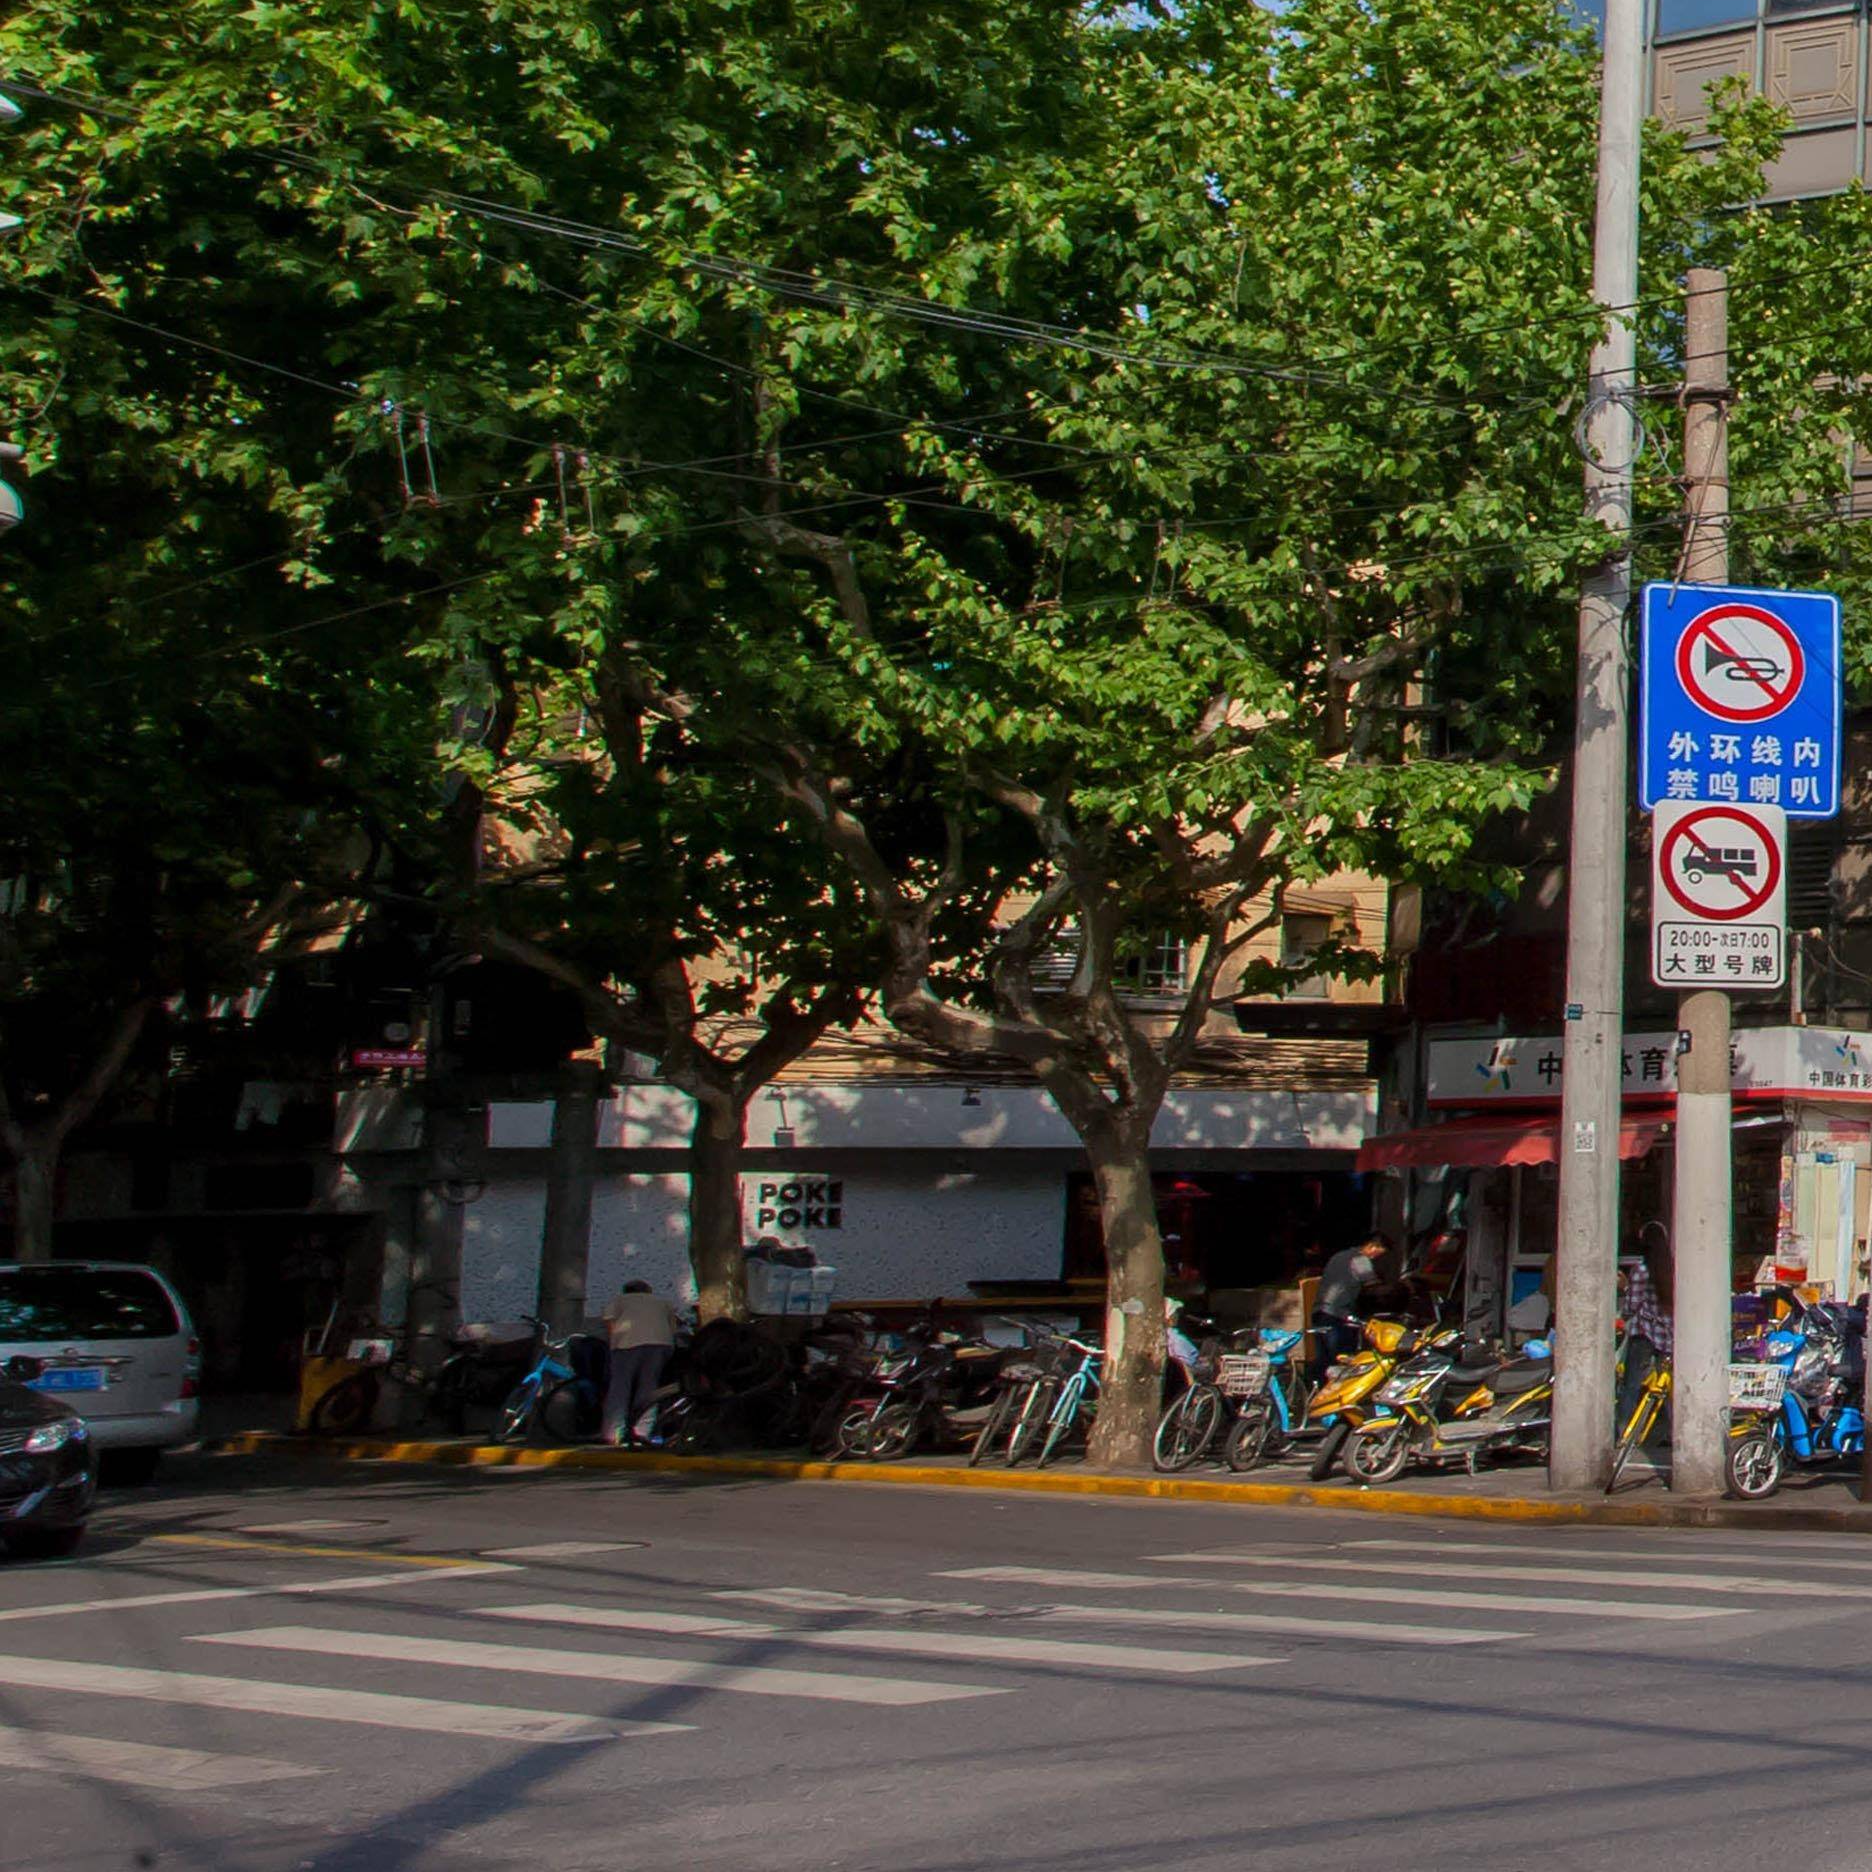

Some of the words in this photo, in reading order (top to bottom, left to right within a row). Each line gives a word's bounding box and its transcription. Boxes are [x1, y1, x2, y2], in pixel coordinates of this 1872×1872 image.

[1667, 730, 1820, 768] 外环线内
[1666, 767, 1821, 805] 禁鸣喇叭
[1670, 930, 1770, 948] 20:00-次日7:00
[1665, 953, 1774, 975] 大型号牌
[759, 1181, 842, 1203] POKE
[757, 1207, 842, 1230] POKE
